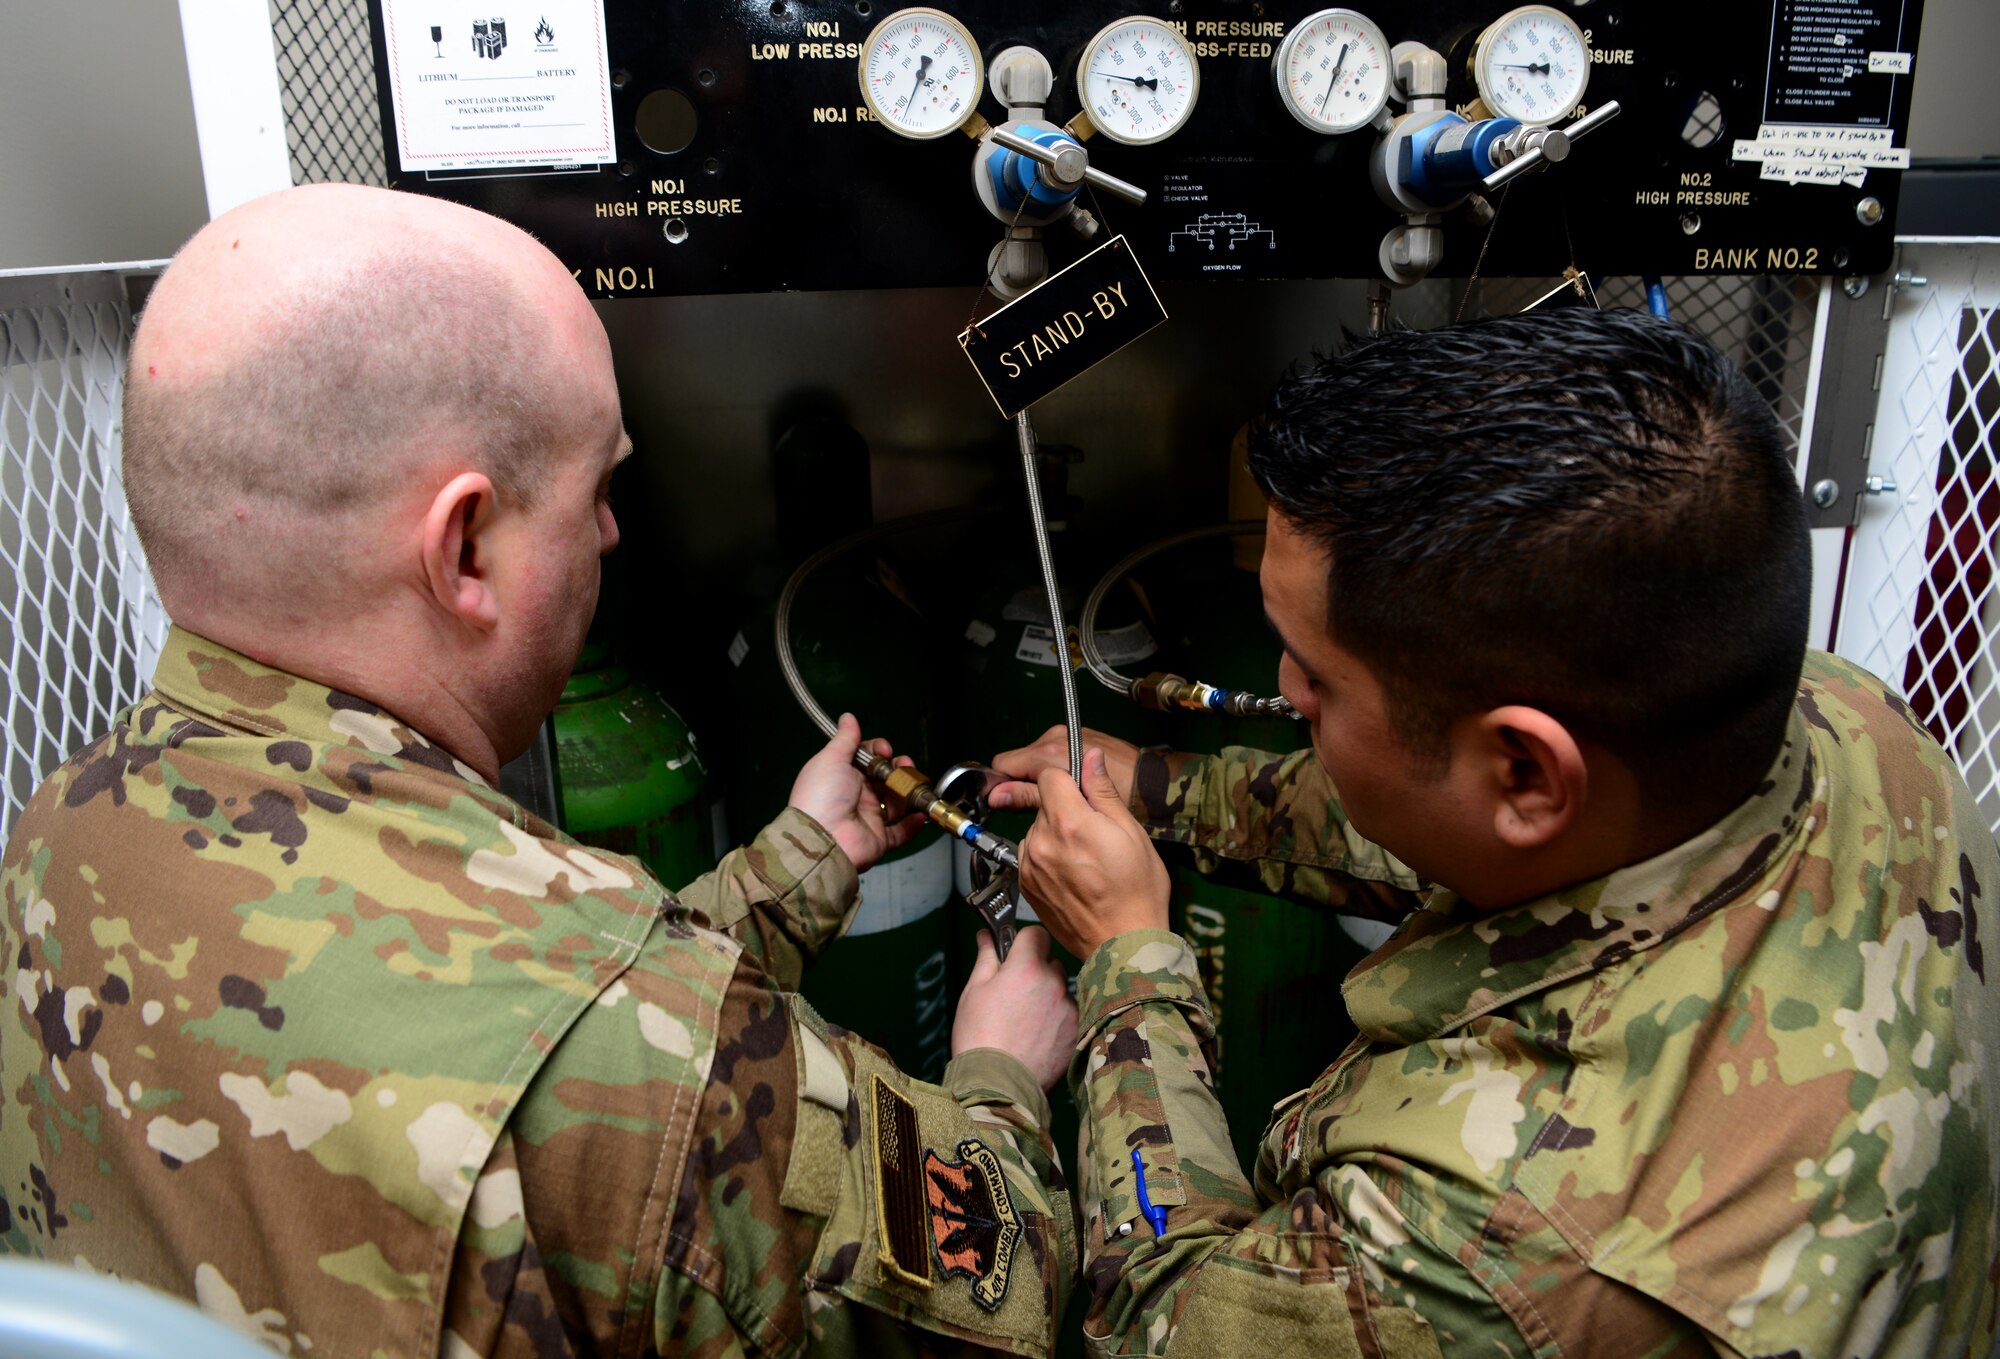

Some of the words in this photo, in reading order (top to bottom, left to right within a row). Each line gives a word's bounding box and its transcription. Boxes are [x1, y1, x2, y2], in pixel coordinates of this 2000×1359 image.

[1814, 16, 1840, 24] REDUCER
[1841, 17, 1872, 25] REGULATOR
[1195, 21, 1285, 38] PRESSURE
[1525, 29, 1540, 46] 1000
[908, 34, 922, 51] 400
[1325, 32, 1337, 46] 400
[1348, 39, 1360, 54] 500
[1506, 39, 1519, 54] 500
[1549, 37, 1563, 54] 1500
[751, 43, 790, 60] LOW
[886, 44, 900, 60] 300
[933, 42, 949, 58] 500
[1110, 50, 1124, 66] 500
[1131, 41, 1147, 59] 1000
[1303, 45, 1316, 59] 300
[901, 54, 912, 69] psi
[1156, 50, 1172, 69] 1500
[1320, 56, 1331, 71] psi
[418, 73, 458, 83] LITHIUM
[536, 69, 577, 78] BATTERY
[882, 70, 896, 86] 200
[945, 65, 960, 81] 600
[1146, 65, 1159, 77] psi
[1301, 71, 1313, 86] 200
[1357, 63, 1370, 78] 600
[1551, 62, 1566, 80] 2000
[1160, 76, 1176, 95] 2000
[1541, 81, 1556, 99] 2500
[444, 98, 456, 106] DO
[457, 97, 475, 105] NOT
[475, 96, 497, 105] LOAD
[498, 96, 510, 104] OR
[510, 94, 556, 103] TRANSPORT
[895, 95, 908, 109] 100
[1148, 96, 1164, 116] 2500
[1313, 93, 1325, 107] 100
[1522, 92, 1536, 109] 3000
[458, 106, 495, 115] PACKAGE
[496, 105, 504, 114] IF
[505, 104, 545, 113] DAMAGED
[1127, 106, 1143, 125] 3000
[1681, 172, 1711, 187] NO.2
[1636, 191, 1670, 205] HIGH
[1676, 191, 1750, 205] PRESSURE
[595, 202, 638, 218] HIGH
[647, 198, 743, 216] PRESSURE
[1695, 248, 1759, 270] BANK
[1767, 248, 1818, 270] NO.2
[1000, 281, 1128, 378] STAND-BY
[979, 1152, 1010, 1215] COMMAND
[996, 1218, 1016, 1273] COMBAT
[991, 1273, 1004, 1296] AIR
